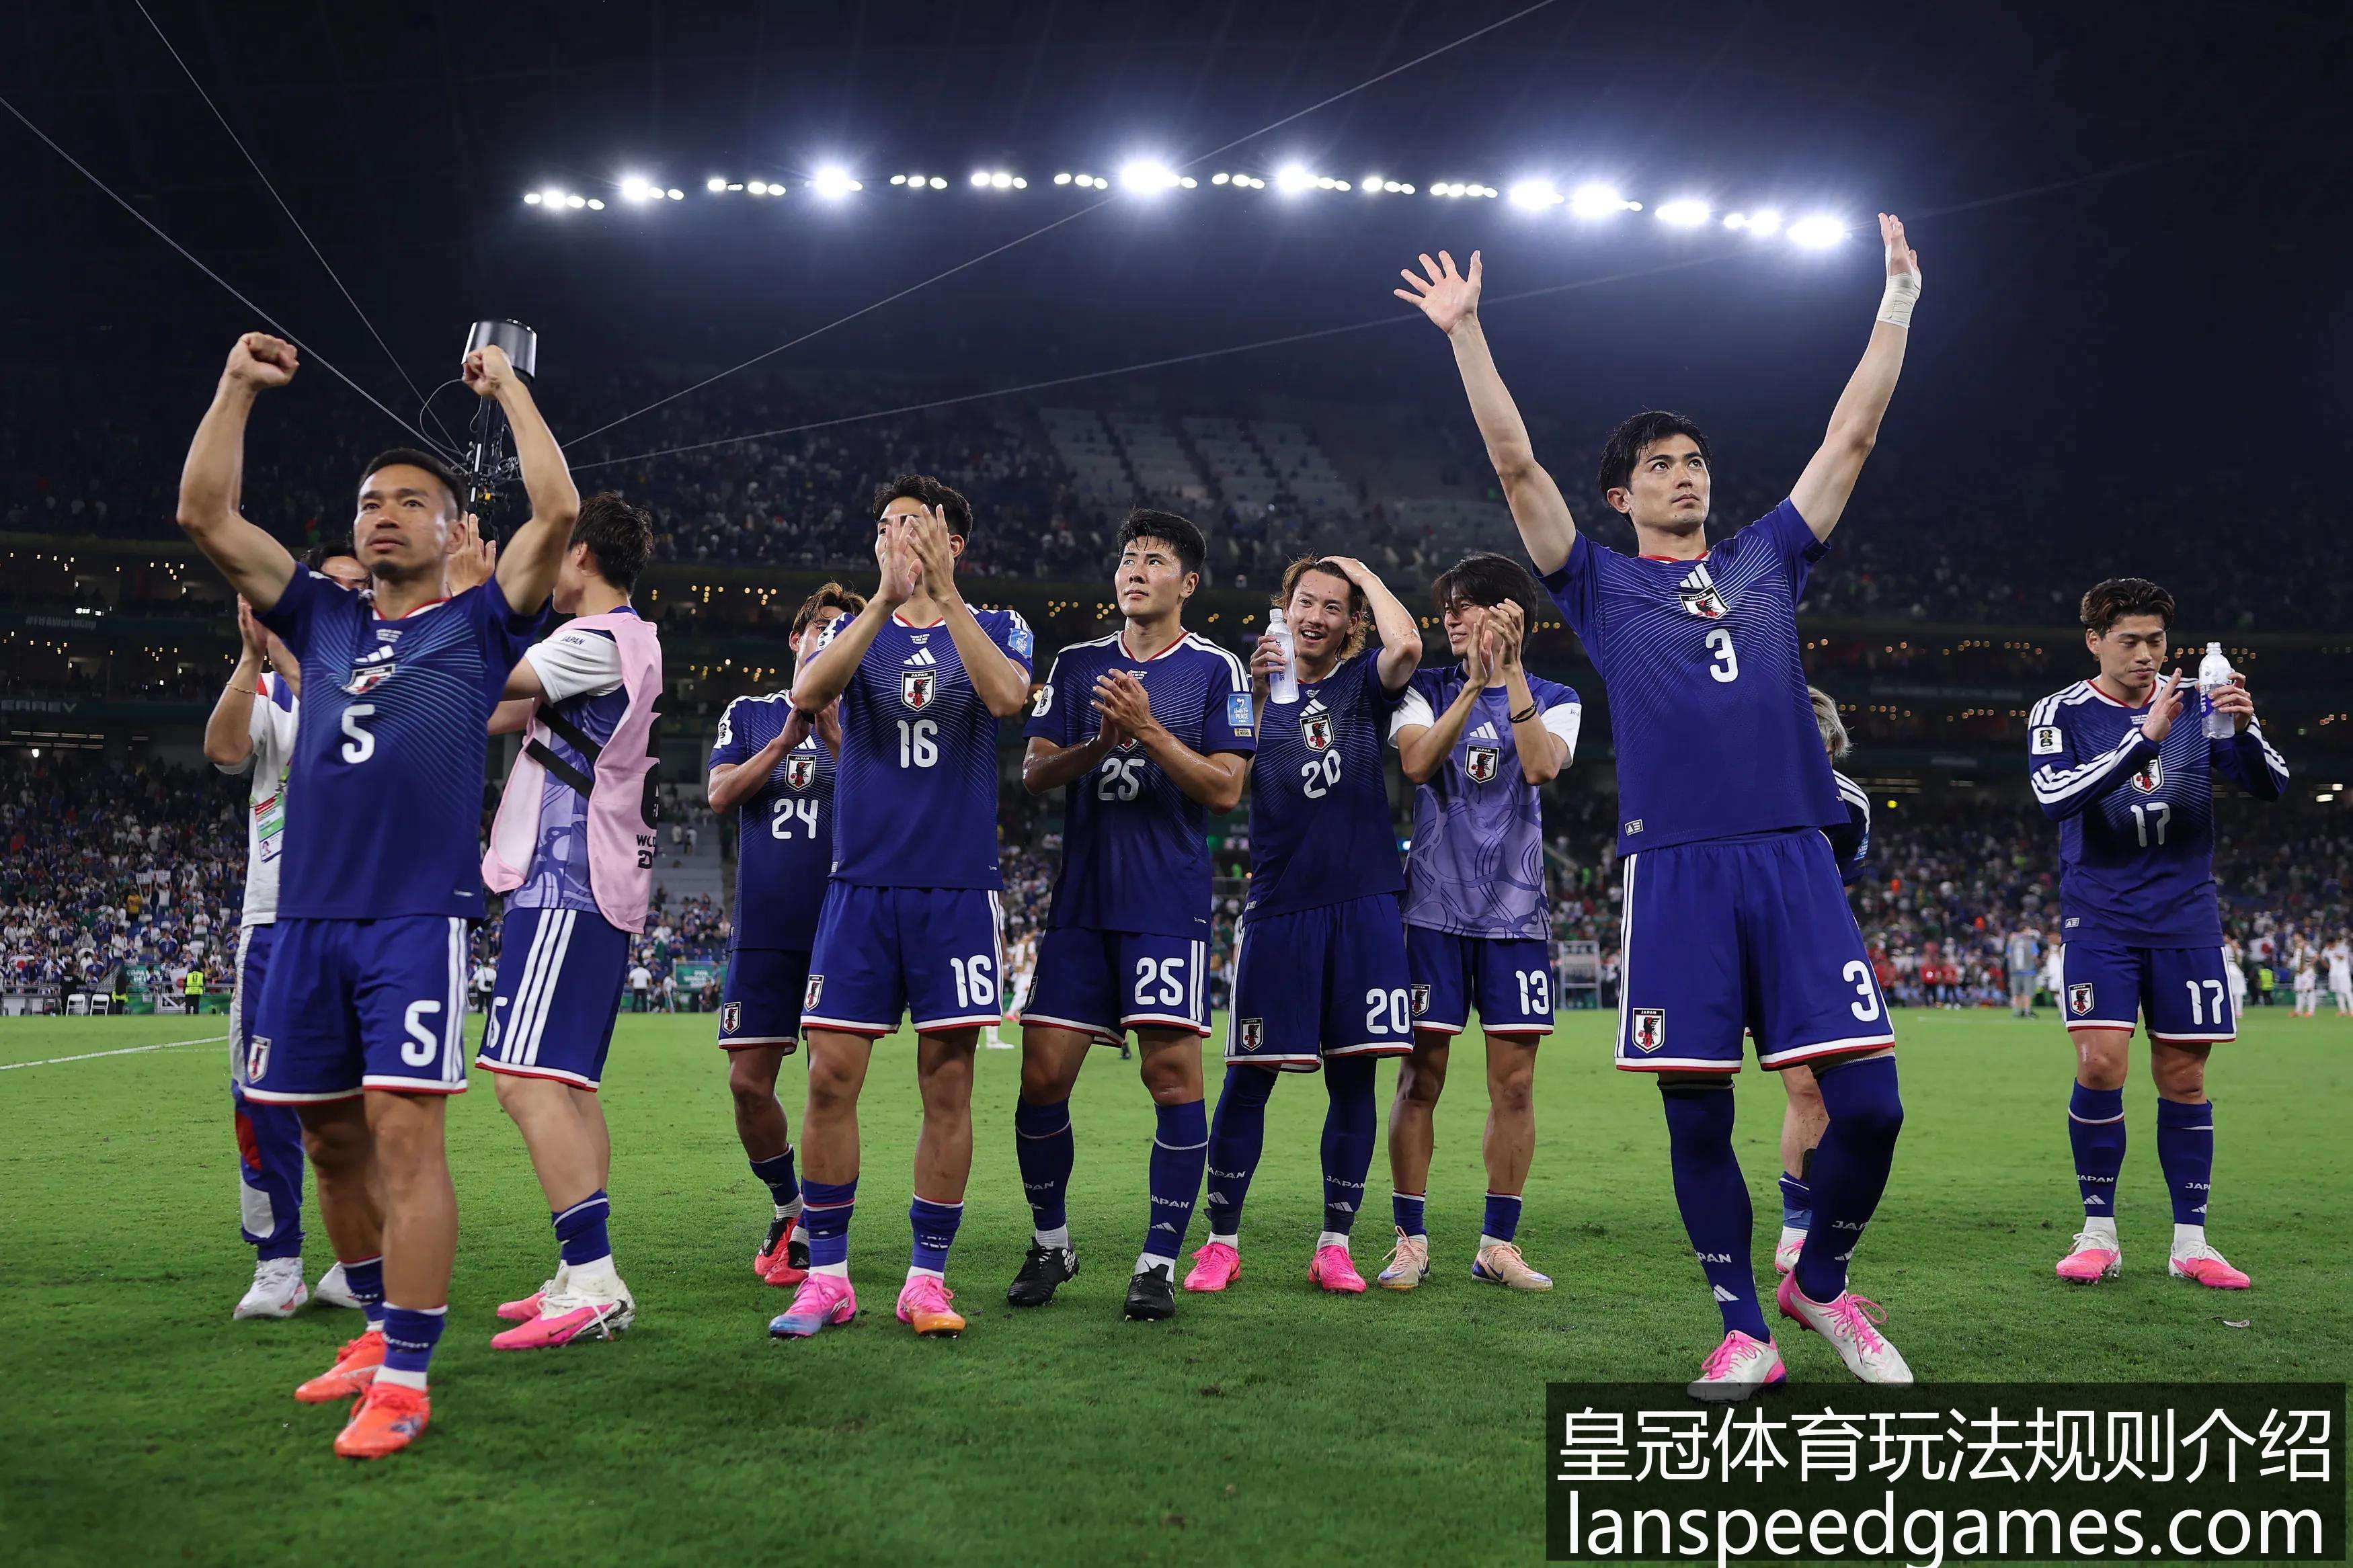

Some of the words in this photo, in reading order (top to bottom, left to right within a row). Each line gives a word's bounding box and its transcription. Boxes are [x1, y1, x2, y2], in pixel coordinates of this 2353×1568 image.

[1688, 592, 1707, 600] JAPAN
[1706, 629, 1739, 683] 3
[342, 704, 374, 764] 5
[897, 719, 939, 768] 16
[1098, 757, 1146, 801] 25
[1301, 749, 1341, 799] 20
[772, 798, 819, 839] 24
[2130, 801, 2171, 848] 17
[950, 954, 994, 1008] 16
[1134, 957, 1185, 1006] 25
[1515, 970, 1550, 1016] 13
[1842, 960, 1880, 1022] 3
[2186, 980, 2225, 1025] 17
[401, 999, 441, 1067] 5
[1366, 988, 1410, 1034] 20
[1207, 1165, 1246, 1179] APAN
[1326, 1175, 1364, 1188] JAPAN
[1694, 1250, 1732, 1264] PAN
